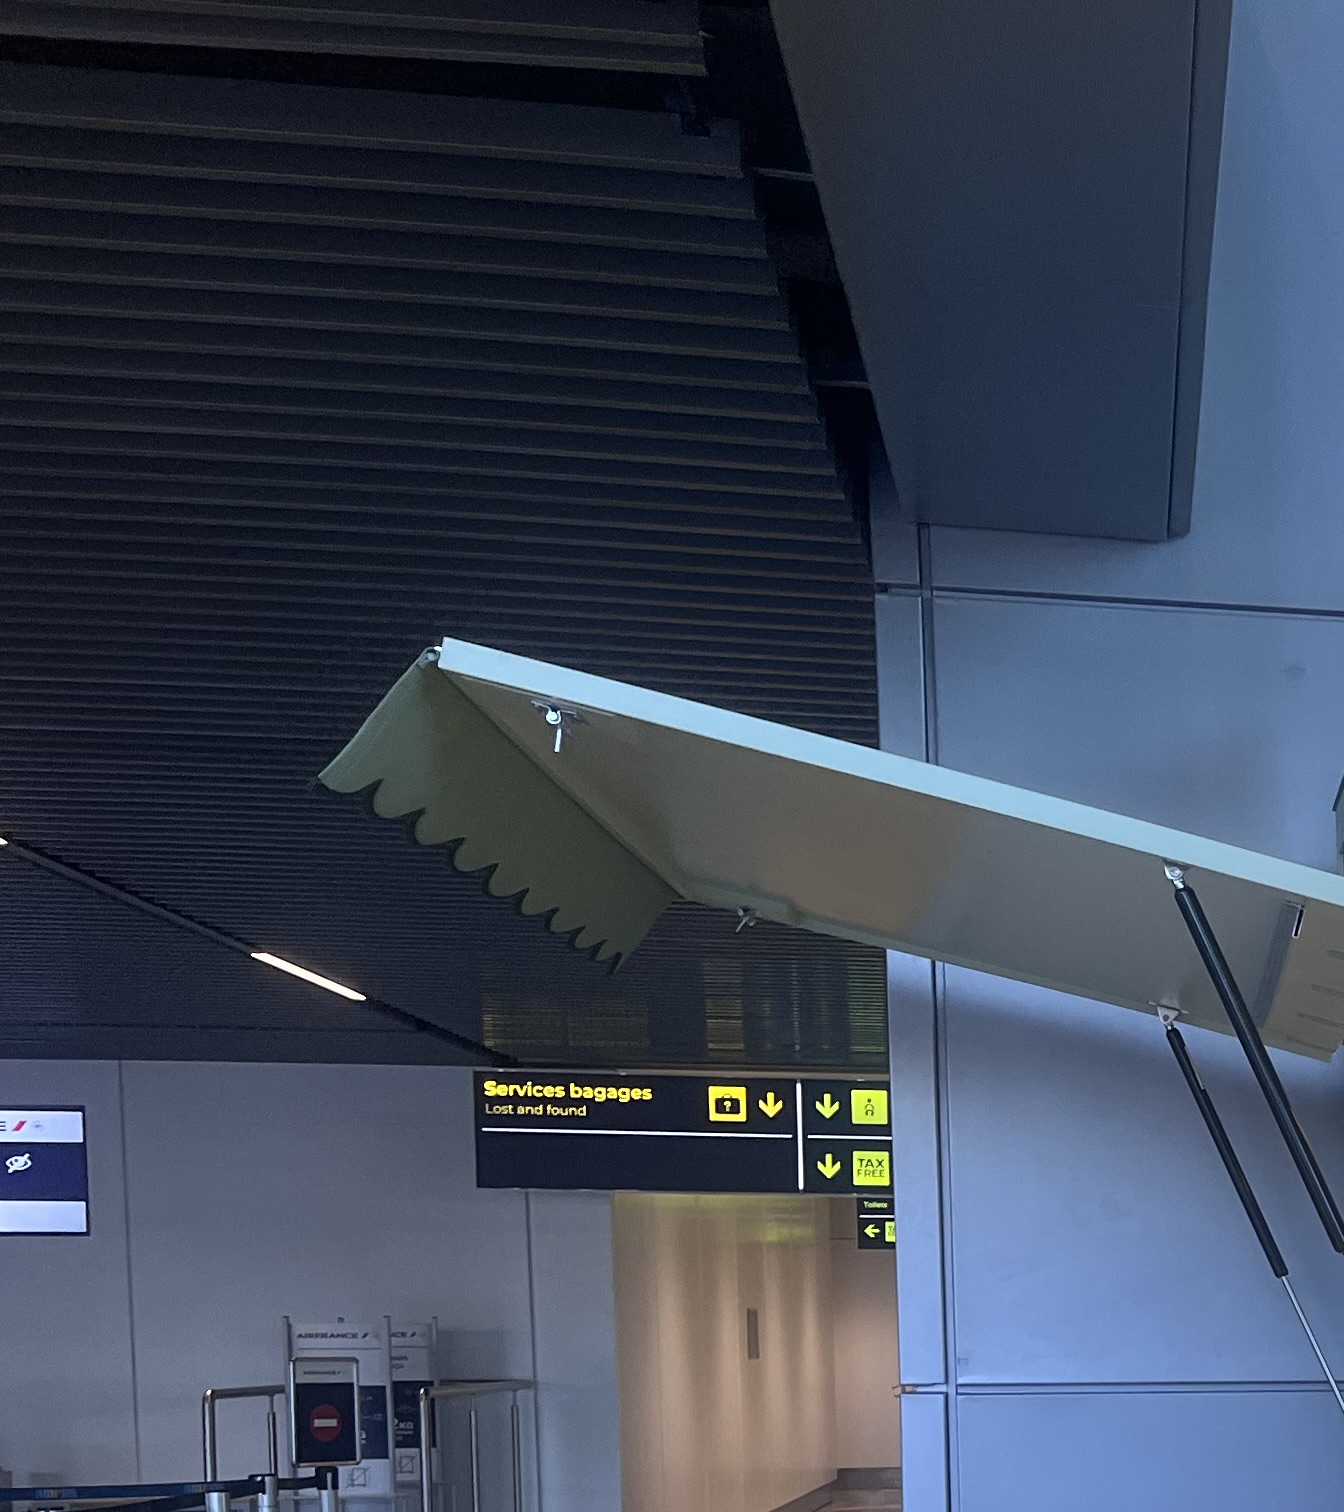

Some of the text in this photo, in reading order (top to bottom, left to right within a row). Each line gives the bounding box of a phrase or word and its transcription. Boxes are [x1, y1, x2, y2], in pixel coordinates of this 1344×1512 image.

[484, 1080, 652, 1102] Services bagages
[485, 1103, 587, 1117] Lost and found
[857, 1158, 885, 1168] TAX
[857, 1169, 886, 1178] FREE
